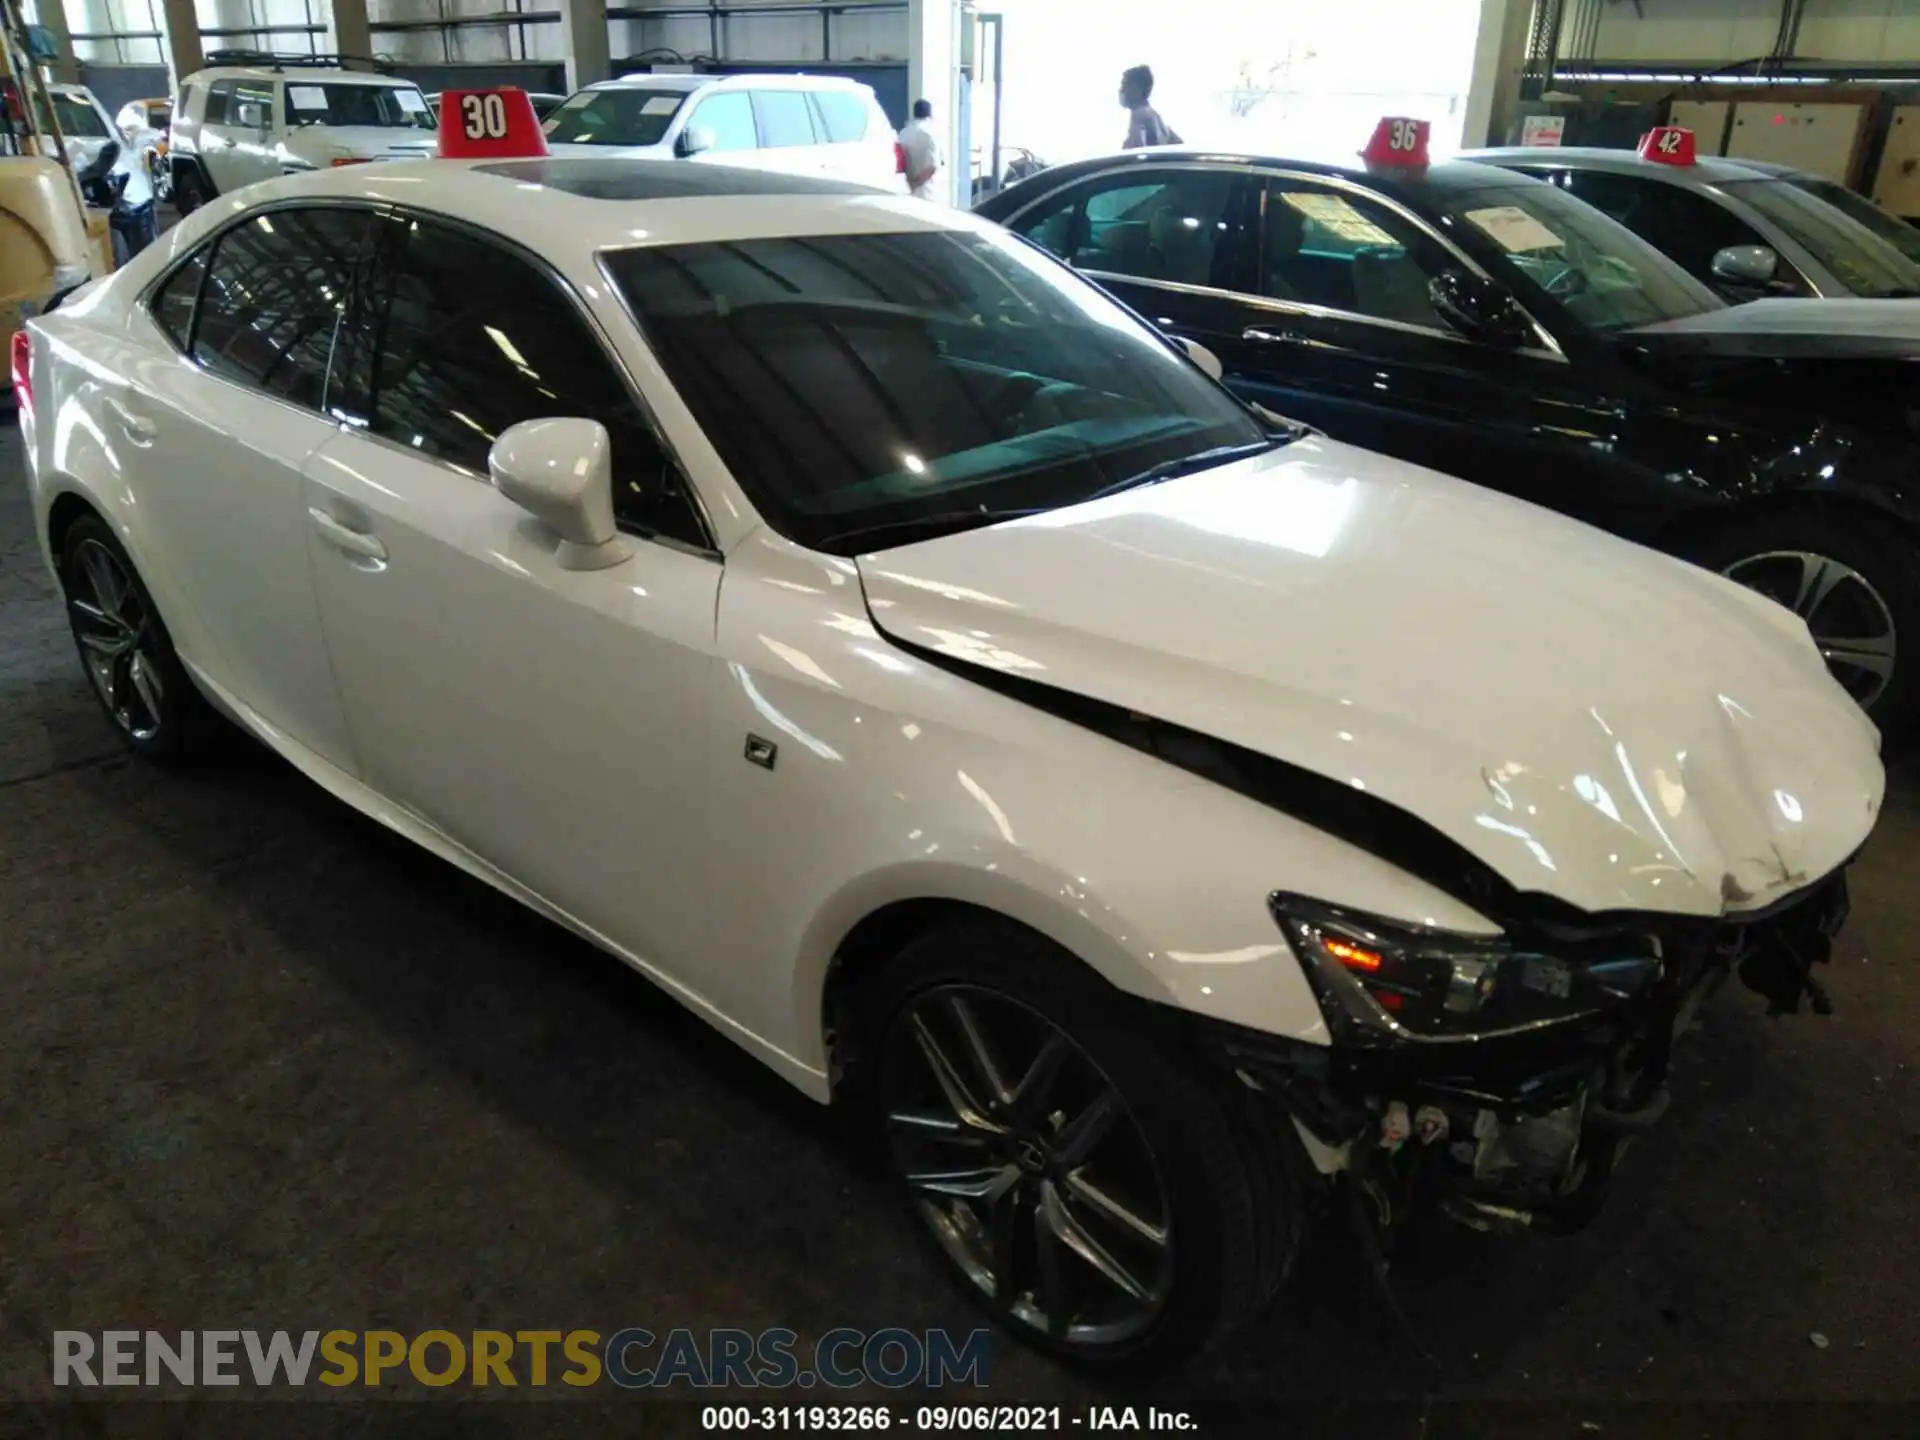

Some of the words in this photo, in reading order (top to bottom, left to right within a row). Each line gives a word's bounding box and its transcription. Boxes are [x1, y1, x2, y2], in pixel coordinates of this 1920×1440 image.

[462, 94, 507, 139] 30
[1389, 120, 1418, 151] 36
[1658, 131, 1682, 154] 42
